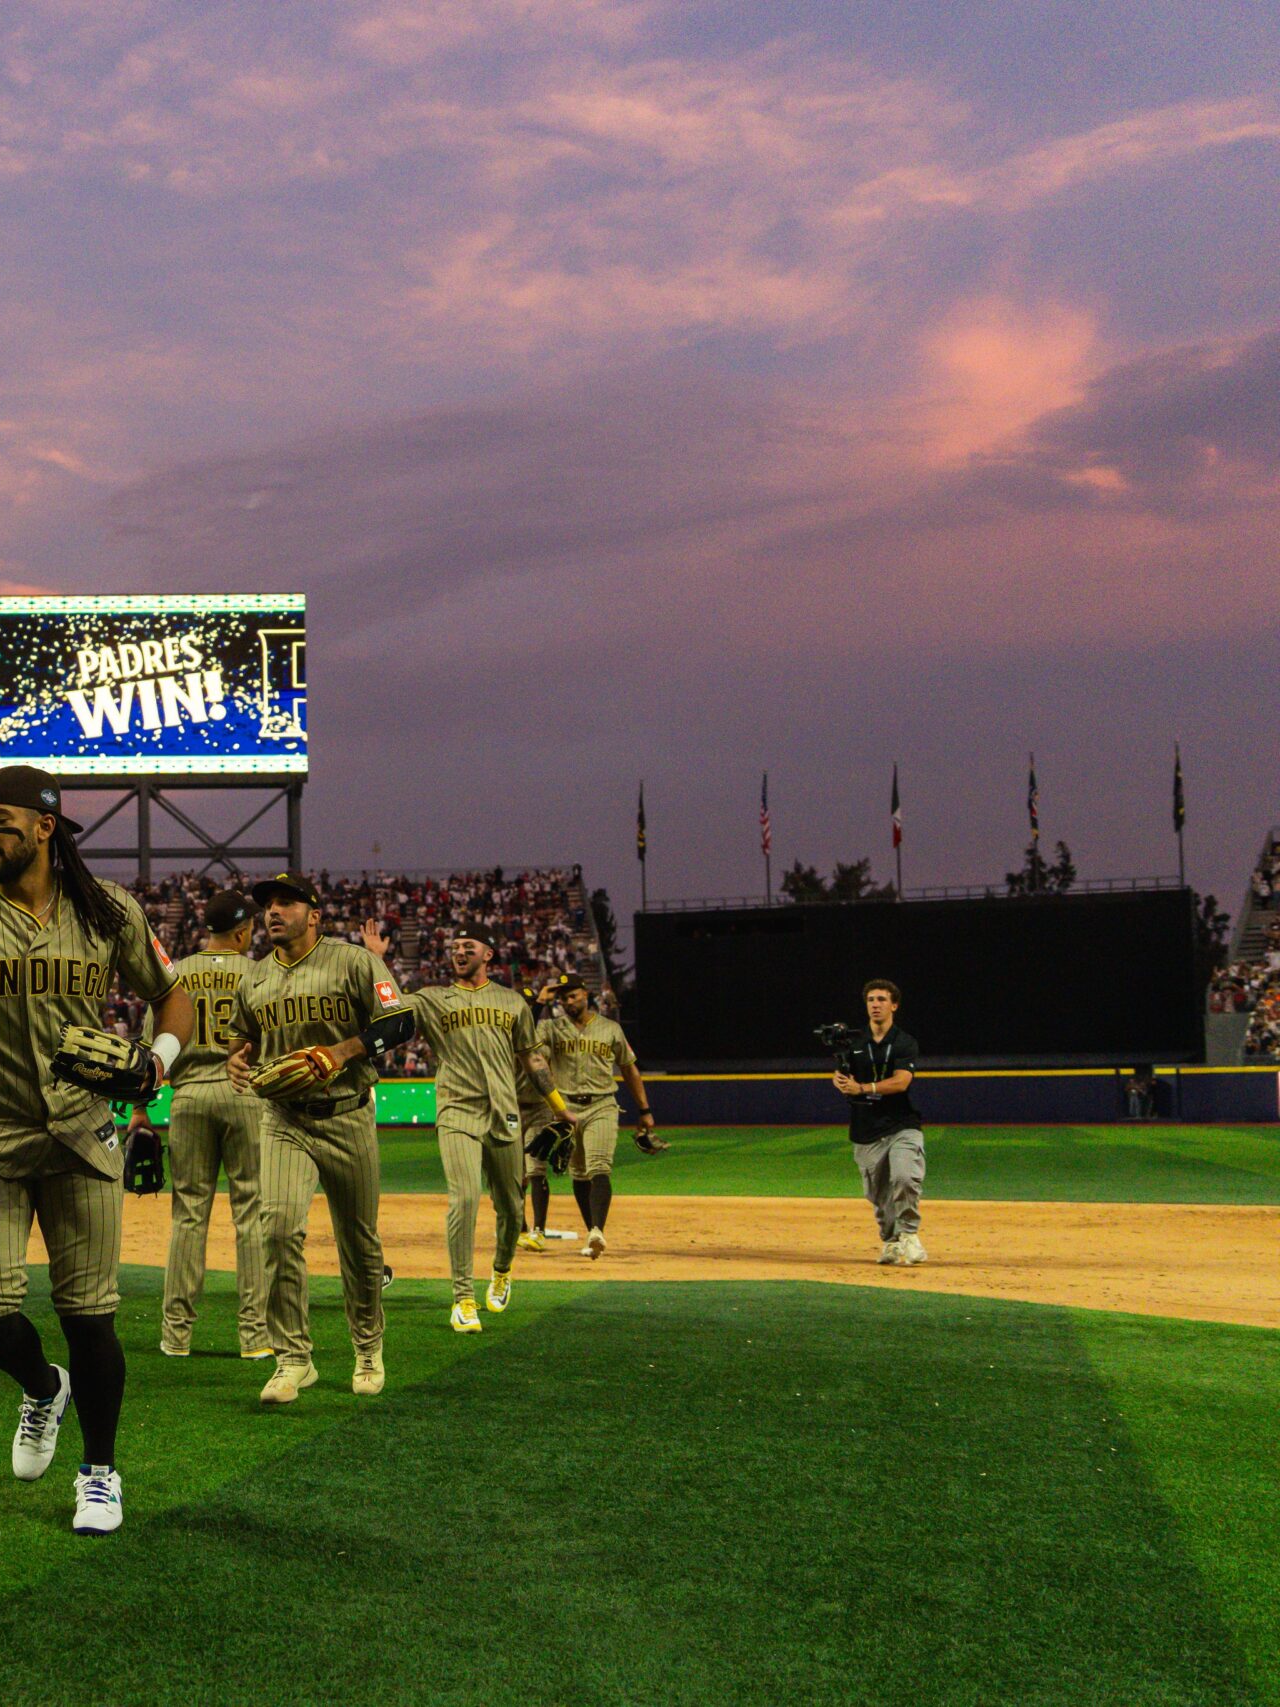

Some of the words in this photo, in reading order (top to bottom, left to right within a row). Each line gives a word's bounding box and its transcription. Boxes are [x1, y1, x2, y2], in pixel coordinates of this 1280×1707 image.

[77, 634, 203, 684] PADRES
[65, 670, 227, 738] WIN!
[179, 971, 244, 992] MACHA
[194, 996, 234, 1047] 13
[255, 1001, 280, 1032] AN
[283, 994, 351, 1024] DIEGO
[441, 1009, 472, 1034] SAN
[554, 1039, 576, 1056] SAN
[579, 1039, 612, 1058] DIEGO
[72, 1062, 113, 1081] Rawlings
